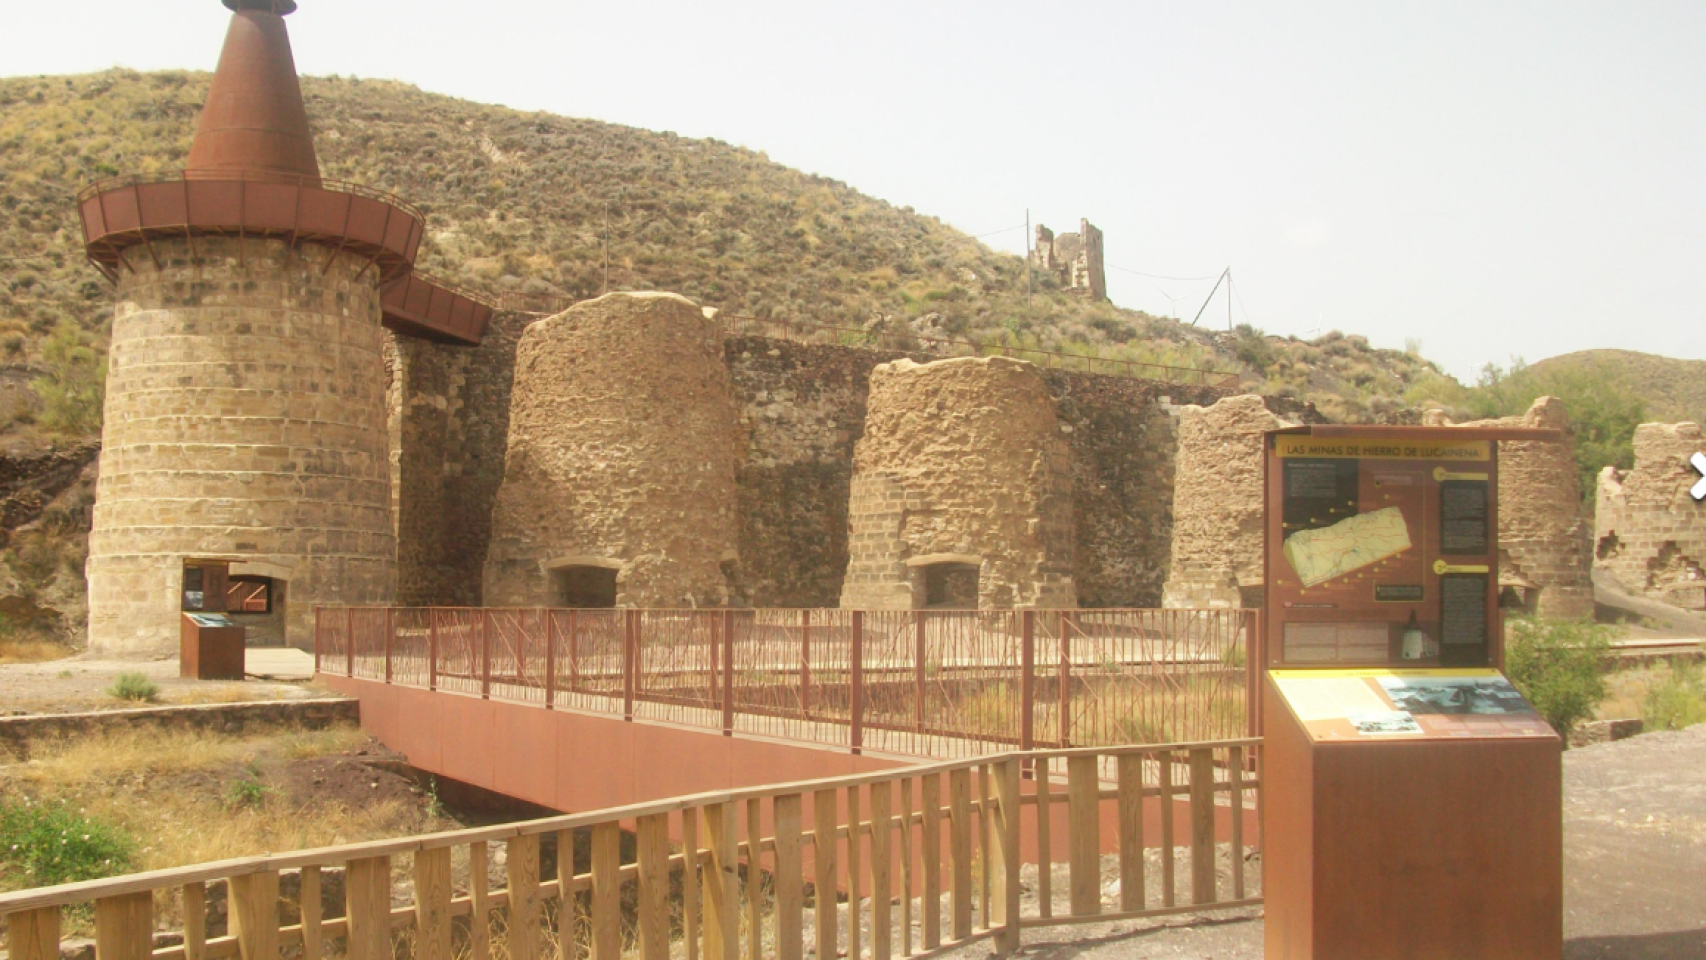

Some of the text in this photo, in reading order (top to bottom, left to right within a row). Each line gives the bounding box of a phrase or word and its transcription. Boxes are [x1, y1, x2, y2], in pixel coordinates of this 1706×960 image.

[1287, 445, 1479, 457] LAS MINAS DE HIERRO DE LUCAINENA
